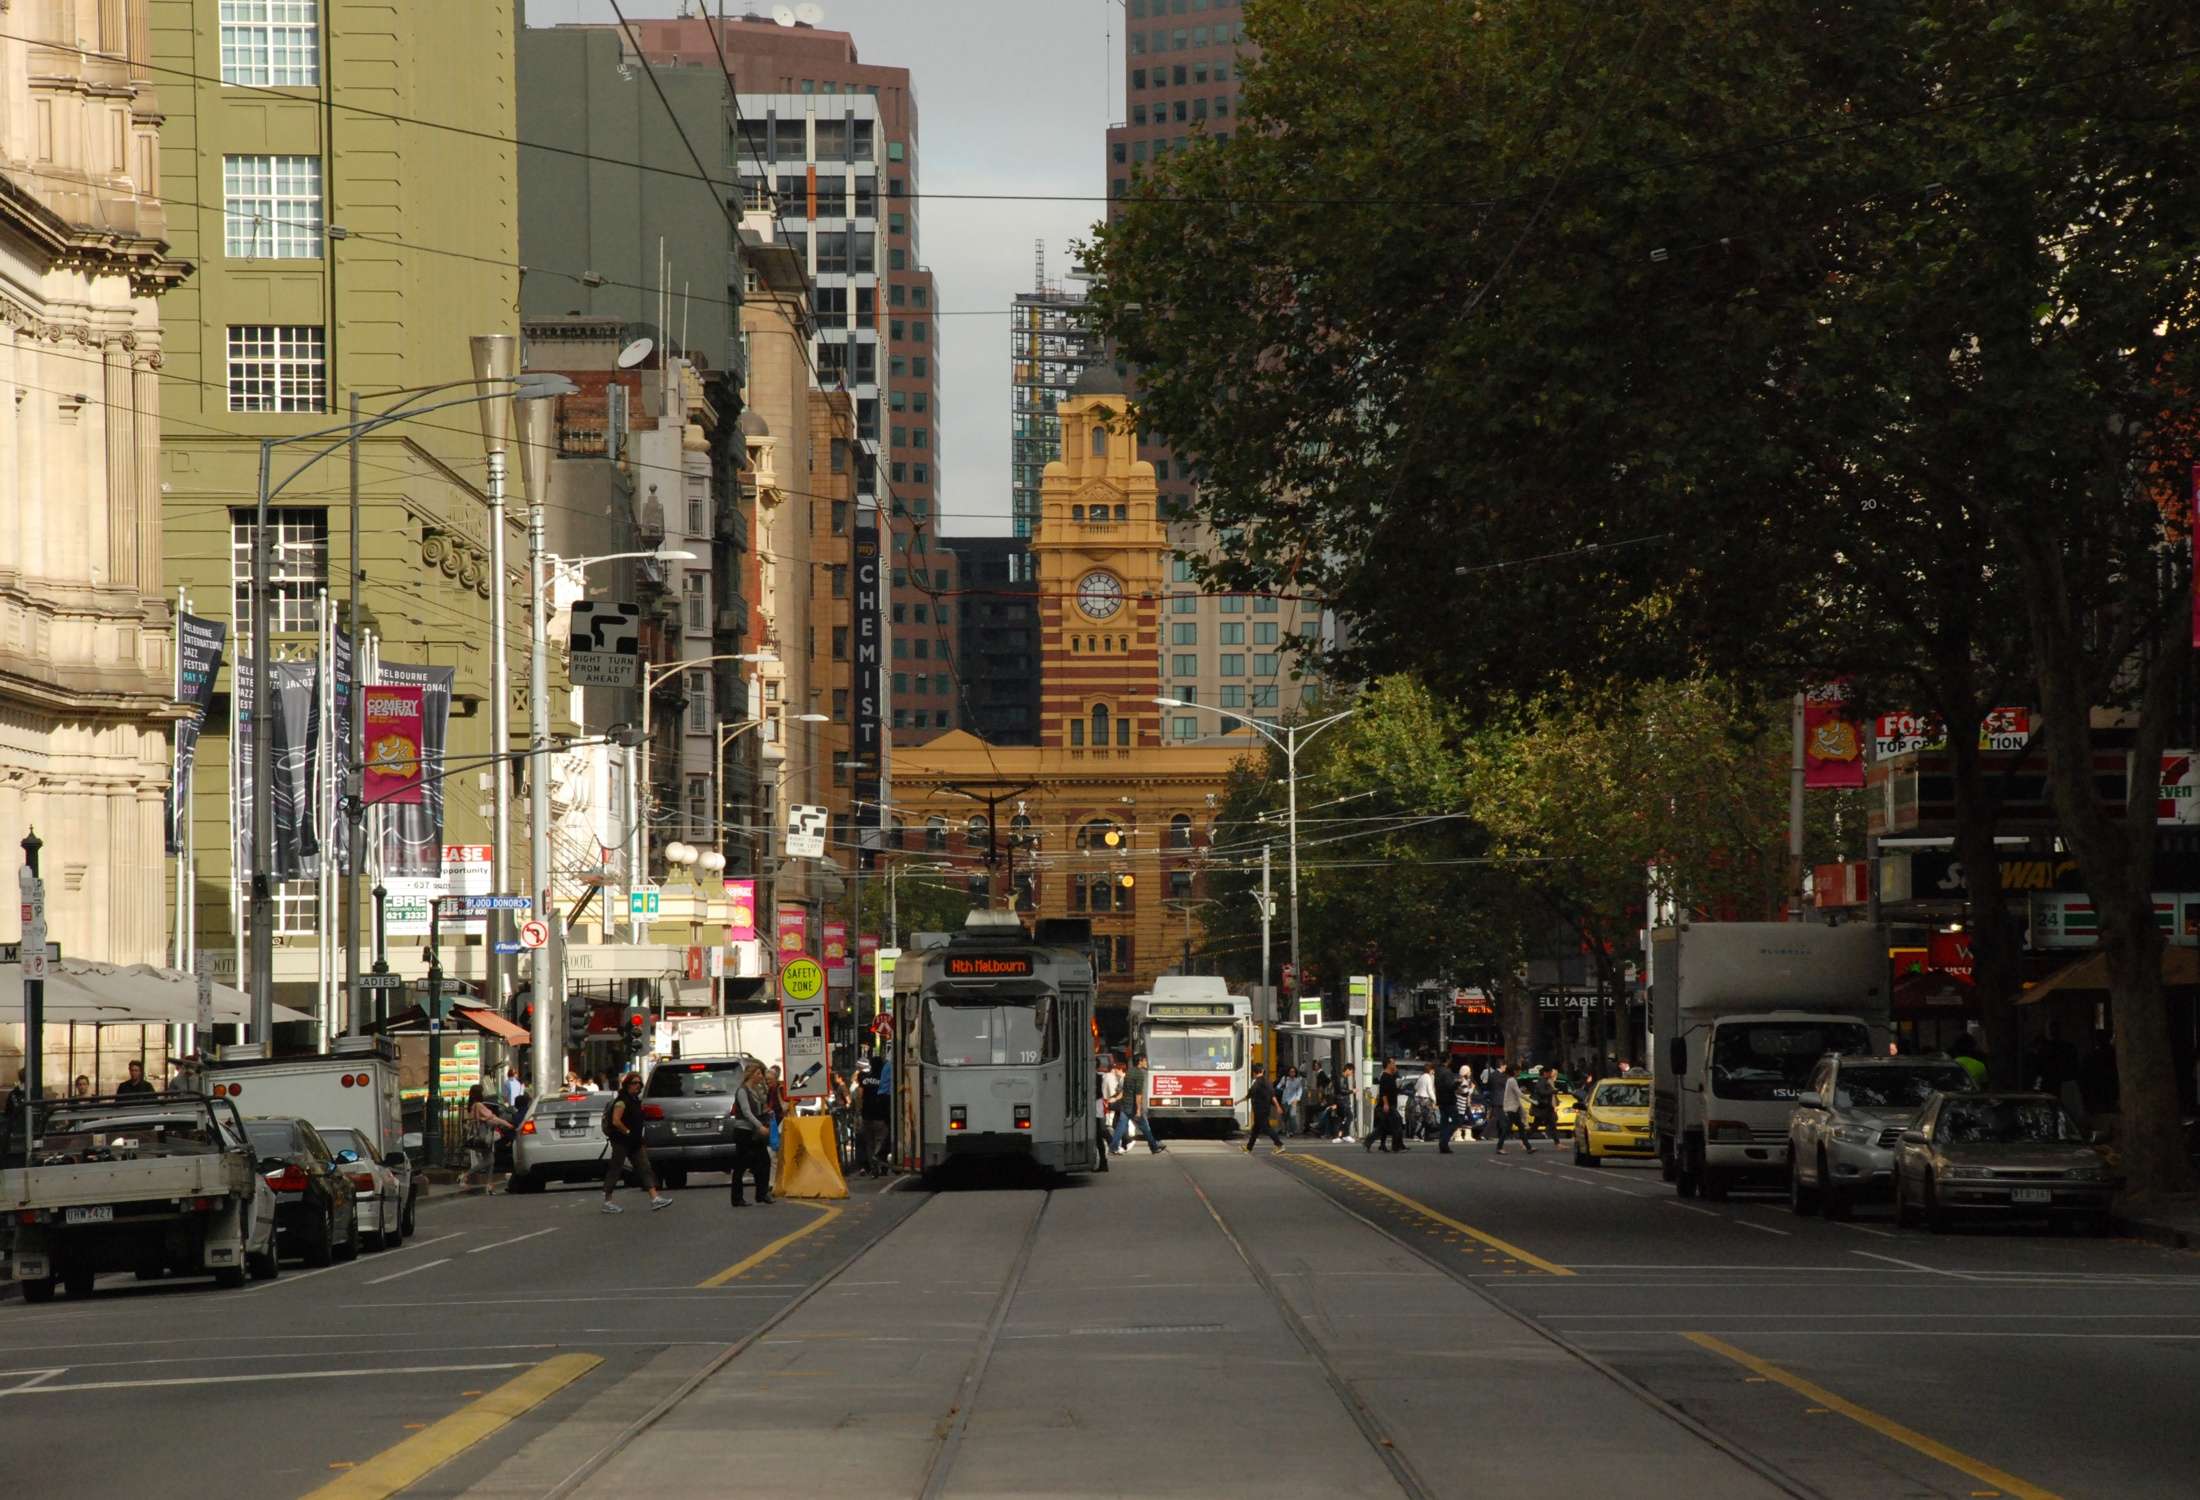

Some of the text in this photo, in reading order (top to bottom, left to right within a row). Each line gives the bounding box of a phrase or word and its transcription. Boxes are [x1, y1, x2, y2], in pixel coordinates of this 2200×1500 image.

[183, 621, 213, 638] MELBOURNE
[184, 646, 198, 658] JAZZ
[859, 564, 875, 742] CHEMIST
[574, 655, 634, 665] RIGHT TURN
[575, 664, 631, 674] FROM LEFT
[376, 669, 428, 681] MELBOURNE
[585, 674, 620, 683] AHEAD
[367, 699, 419, 709] COMEDY
[367, 707, 419, 717] FESTIVAL
[1877, 741, 1906, 753] TOP
[493, 899, 523, 908] DONORS
[2038, 911, 2057, 927] 24
[787, 968, 817, 979] SAFETY
[792, 981, 814, 993] ZONE
[1020, 1051, 1037, 1063] 119
[1215, 1062, 1233, 1070] 2081
